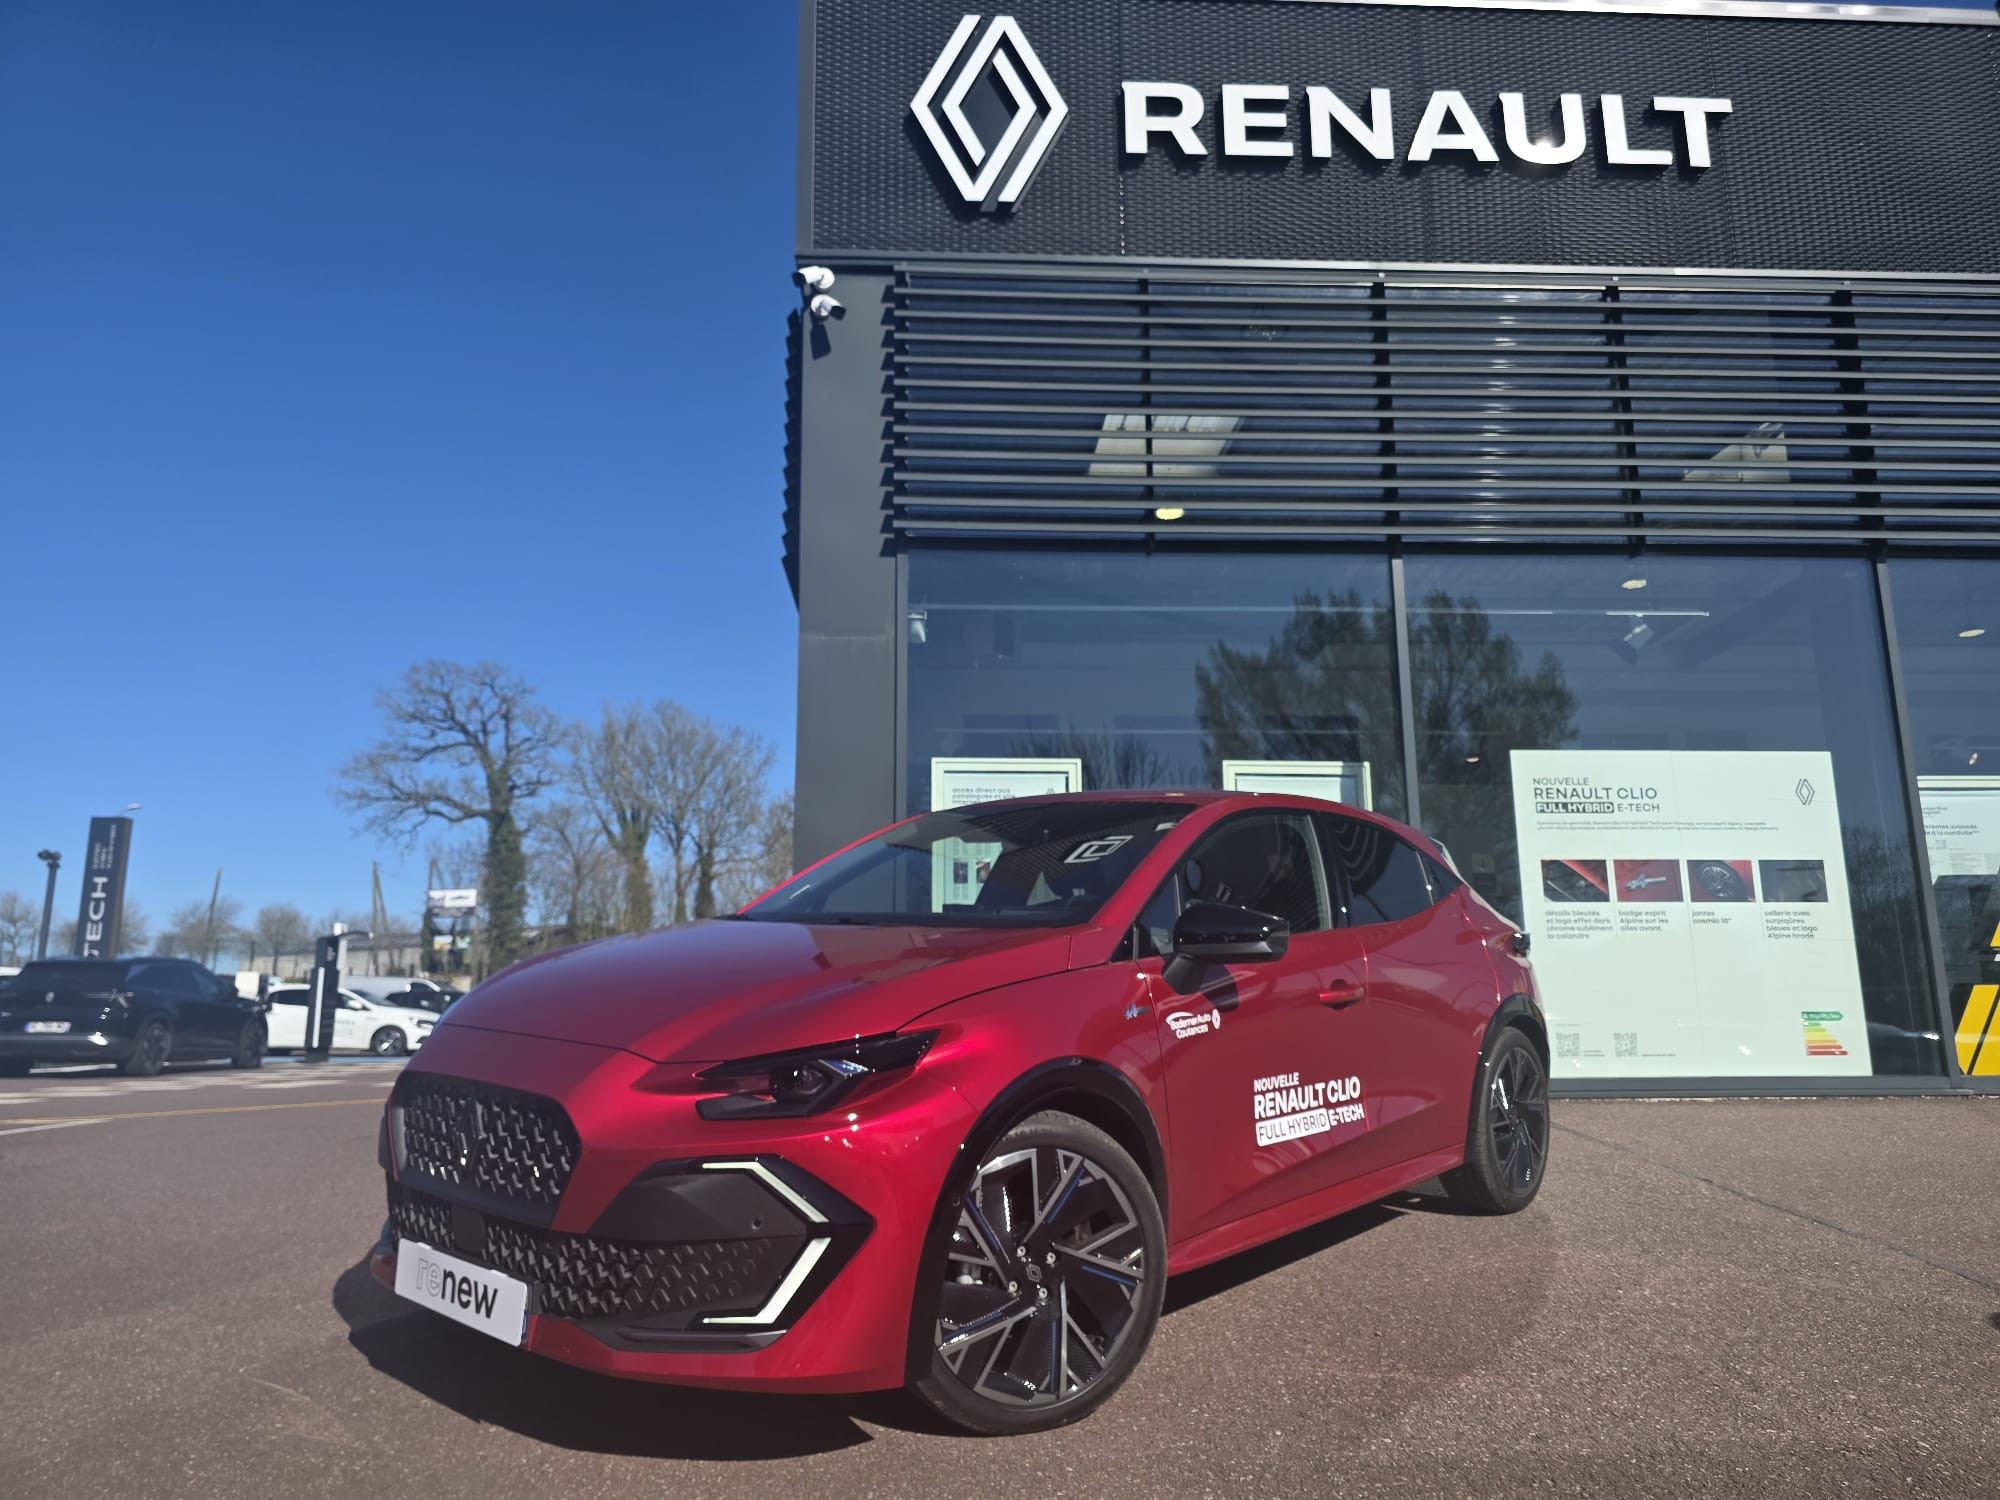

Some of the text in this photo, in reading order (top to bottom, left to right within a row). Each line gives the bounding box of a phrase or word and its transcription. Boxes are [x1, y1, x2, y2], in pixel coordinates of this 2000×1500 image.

[1121, 81, 1733, 168] RENAULT
[1532, 777, 1589, 786] NOUVELLE
[1534, 787, 1658, 800] RENAULT CLIO
[1536, 802, 1660, 813] FULL HYBRID E-TECH
[1644, 910, 1666, 918] esprit
[1692, 910, 1715, 918] jantes
[1620, 918, 1643, 926] Alpine
[1254, 1072, 1300, 1093] NOUVELLE
[1254, 1076, 1361, 1119] RENAULT CLIO
[1258, 1103, 1365, 1142] FULL HYBRID E-TECH
[416, 1257, 498, 1320] renew
